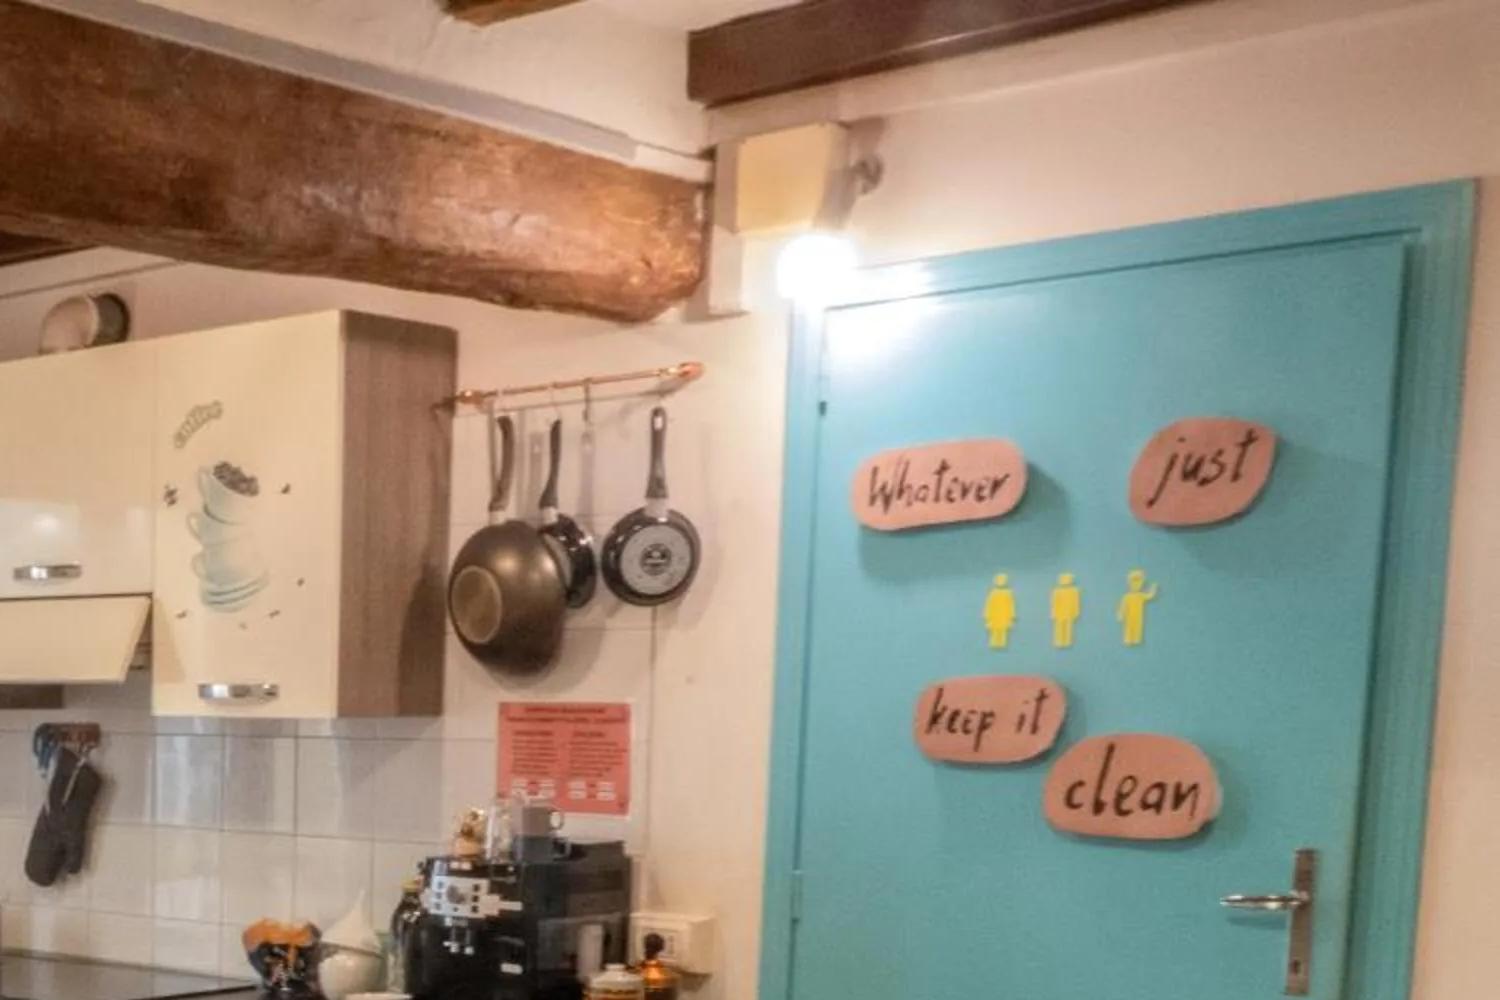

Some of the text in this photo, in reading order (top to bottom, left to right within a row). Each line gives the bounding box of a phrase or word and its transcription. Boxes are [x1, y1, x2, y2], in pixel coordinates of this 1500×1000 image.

[867, 457, 1012, 515] Whatever
[1145, 427, 1261, 509] just
[924, 687, 1050, 753] keep it
[1063, 742, 1202, 820] clean
